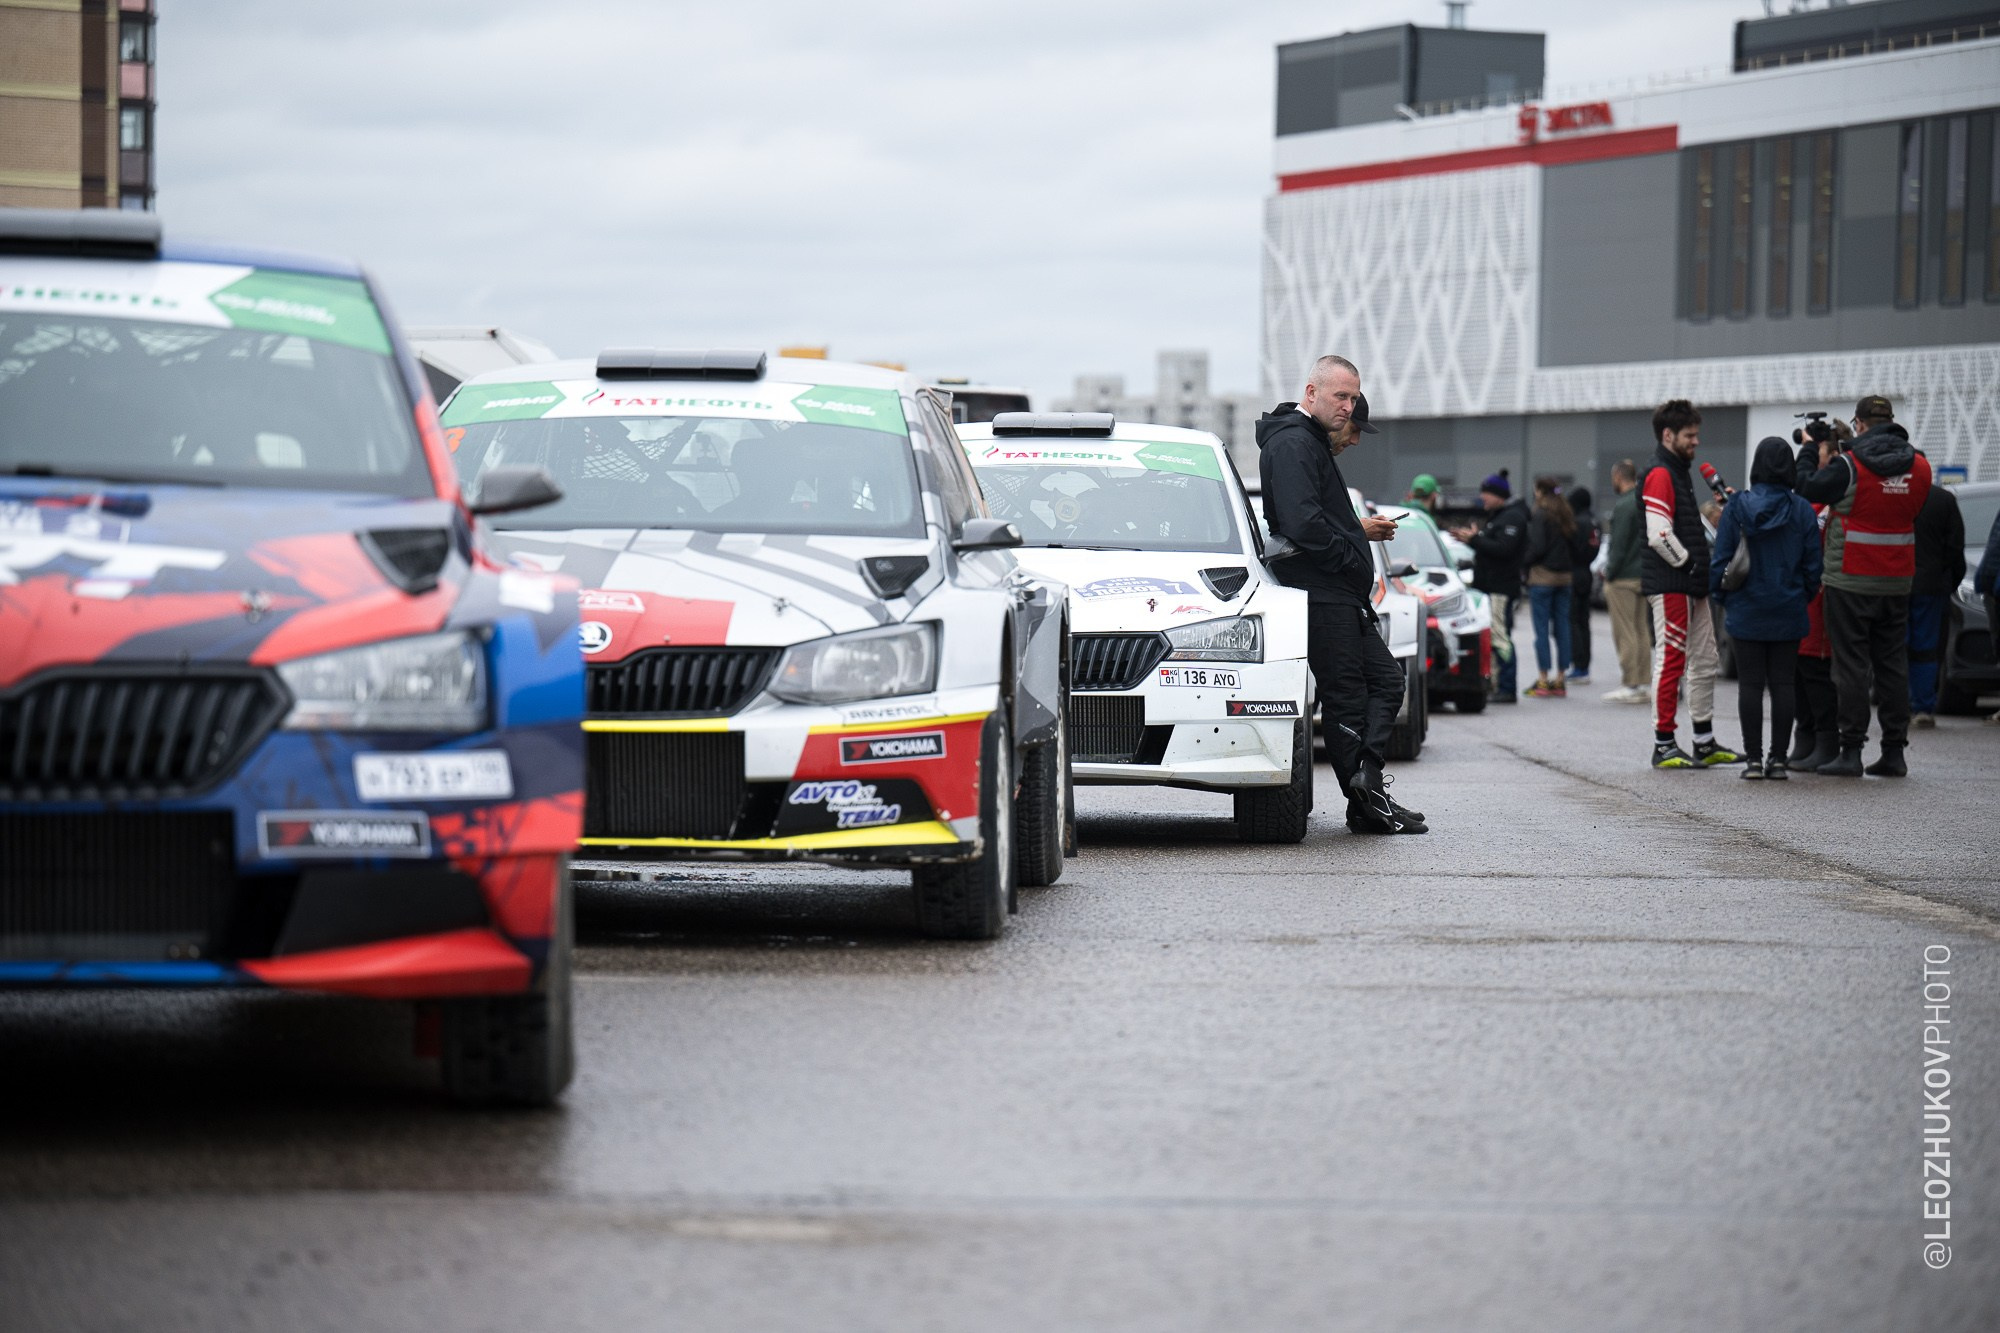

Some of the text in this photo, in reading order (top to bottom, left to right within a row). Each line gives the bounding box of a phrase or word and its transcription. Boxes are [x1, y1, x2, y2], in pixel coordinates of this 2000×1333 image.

[0, 286, 180, 309] НЕФТЬ
[610, 398, 773, 410] ТАТНЕФТЬ
[1002, 452, 1122, 461] ТАТНЕФТЬ
[1095, 586, 1162, 597] ПСКОВ
[1165, 582, 1184, 595] 7
[1165, 670, 1236, 687] 01 136 AYO
[1244, 703, 1294, 714] YOKOHAMA
[869, 738, 938, 758] YOKOHAMA
[791, 782, 861, 803] AVTO
